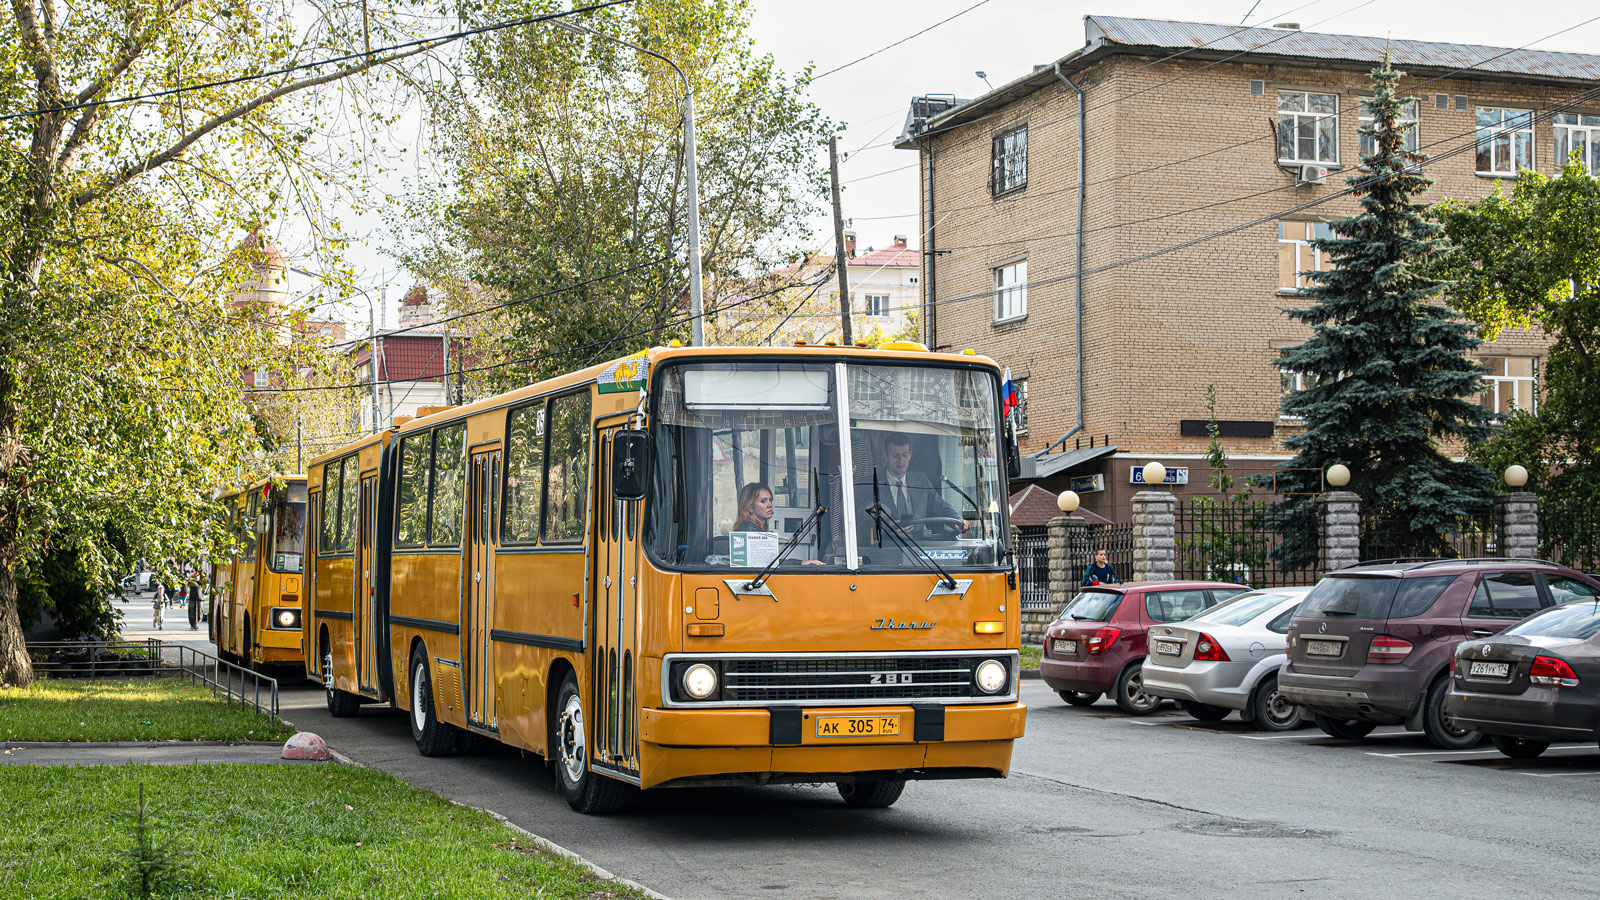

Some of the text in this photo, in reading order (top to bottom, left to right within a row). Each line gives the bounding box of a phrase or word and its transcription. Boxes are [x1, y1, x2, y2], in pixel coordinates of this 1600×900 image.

[1135, 471, 1142, 482] 6
[870, 618, 936, 629] Ikarus
[870, 673, 913, 684] 280
[848, 719, 874, 733] 305
[881, 718, 894, 729] 74
